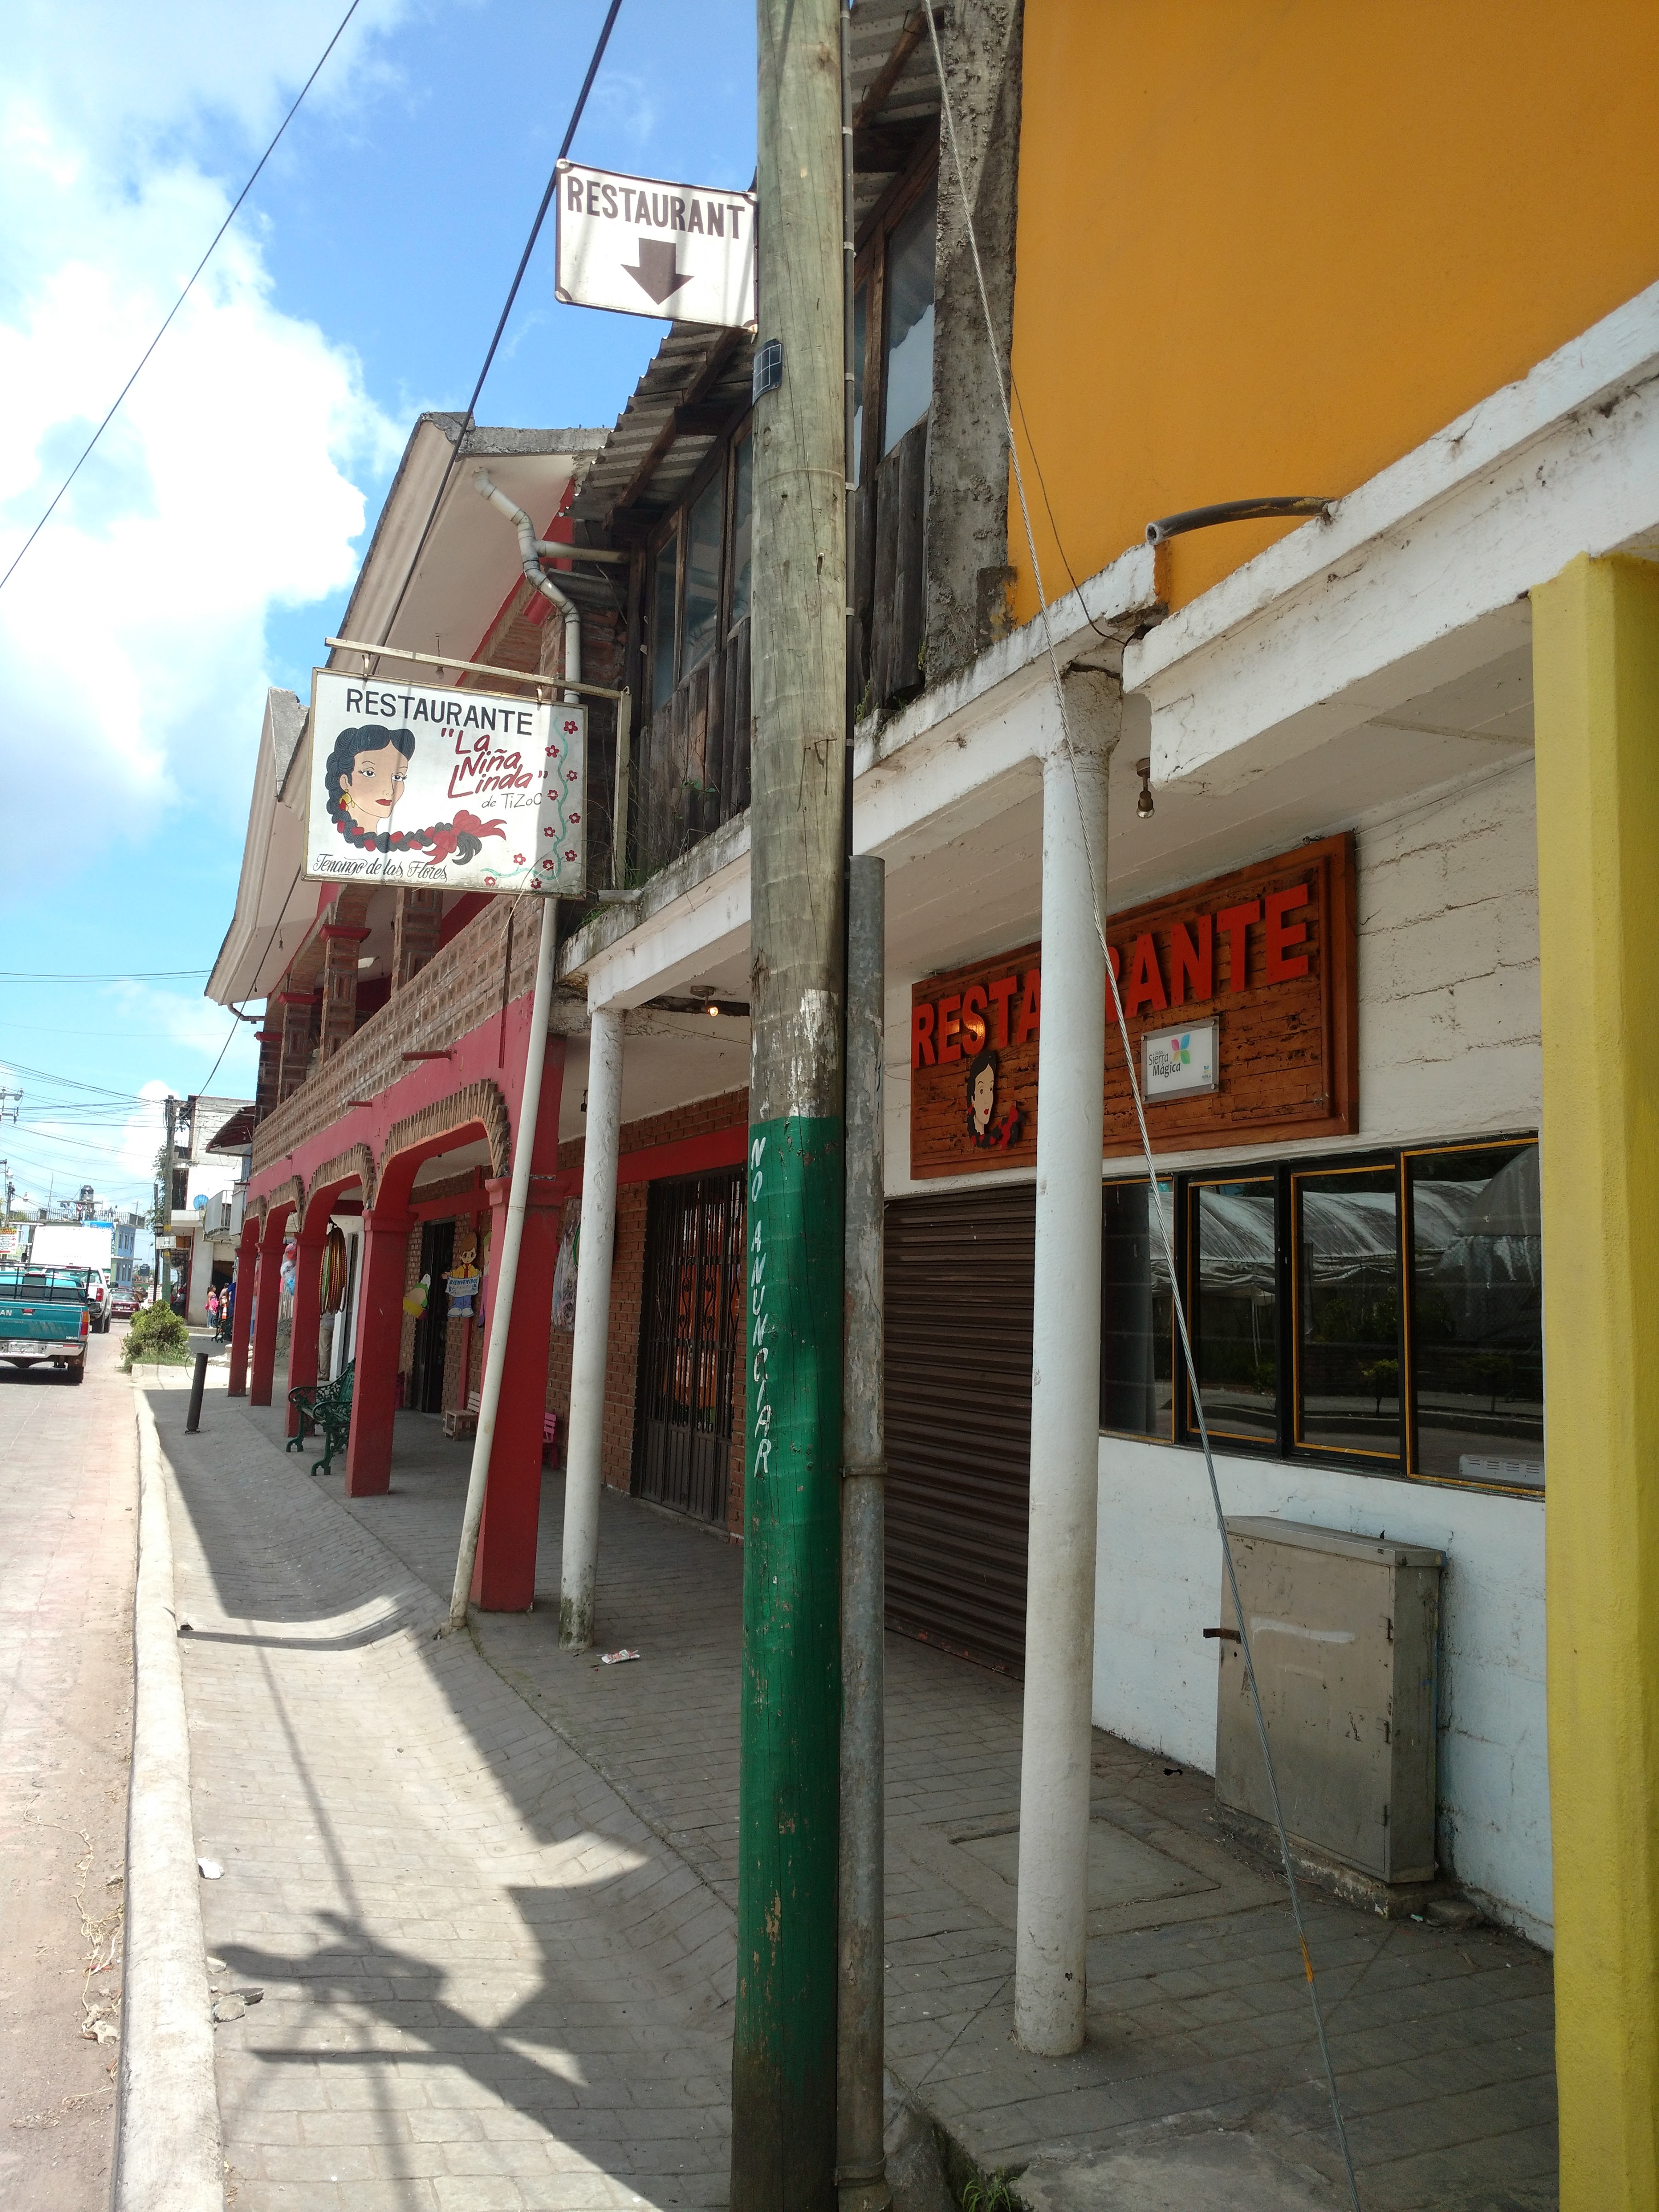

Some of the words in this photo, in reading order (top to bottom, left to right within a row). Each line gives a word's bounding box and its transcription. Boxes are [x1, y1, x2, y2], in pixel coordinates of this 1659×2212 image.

[567, 175, 745, 239] RESTAURANT
[346, 688, 533, 736] RESTAURANTE
[459, 748, 522, 781] Niña
[481, 795, 497, 808] de
[313, 853, 368, 876] Tenango
[366, 858, 382, 875] de
[382, 859, 403, 878] las
[407, 861, 447, 882] Flores
[912, 883, 1310, 1069] RESTAANTE
[1148, 1053, 1168, 1065] Sierra
[1153, 1061, 1181, 1078] Mágica
[751, 1137, 766, 1202] NO
